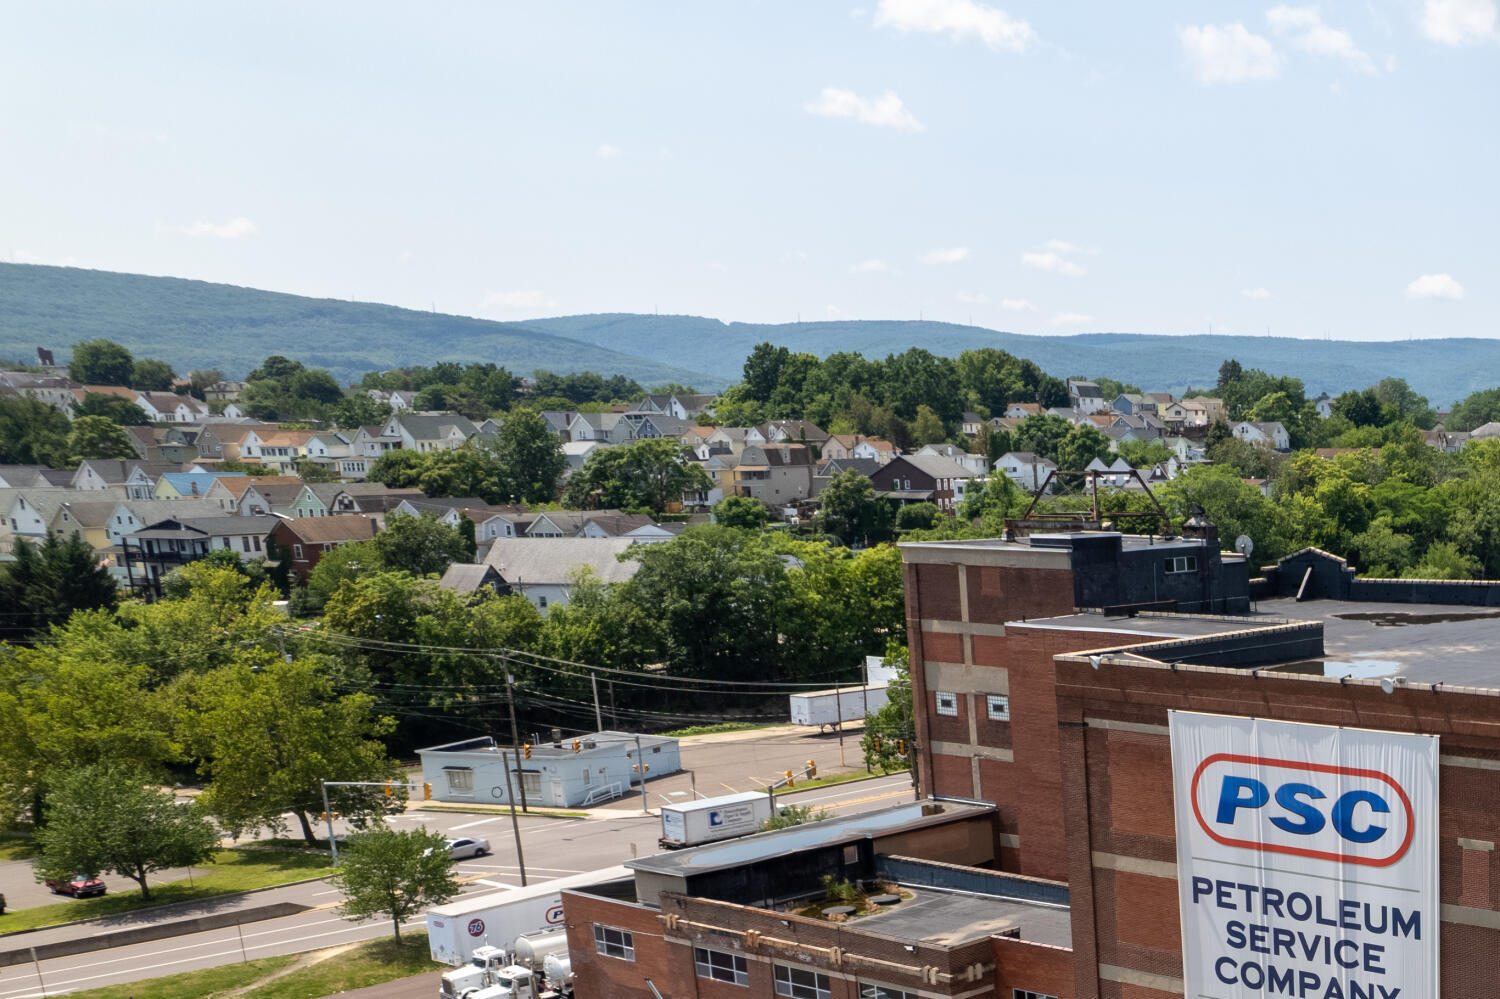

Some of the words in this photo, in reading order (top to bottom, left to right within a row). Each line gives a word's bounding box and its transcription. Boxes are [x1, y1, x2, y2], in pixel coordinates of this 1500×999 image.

[1216, 775, 1391, 843] PSC
[471, 921, 482, 933] 76
[1192, 876, 1421, 940] PETROLEUM
[1226, 920, 1385, 975] SERVICE
